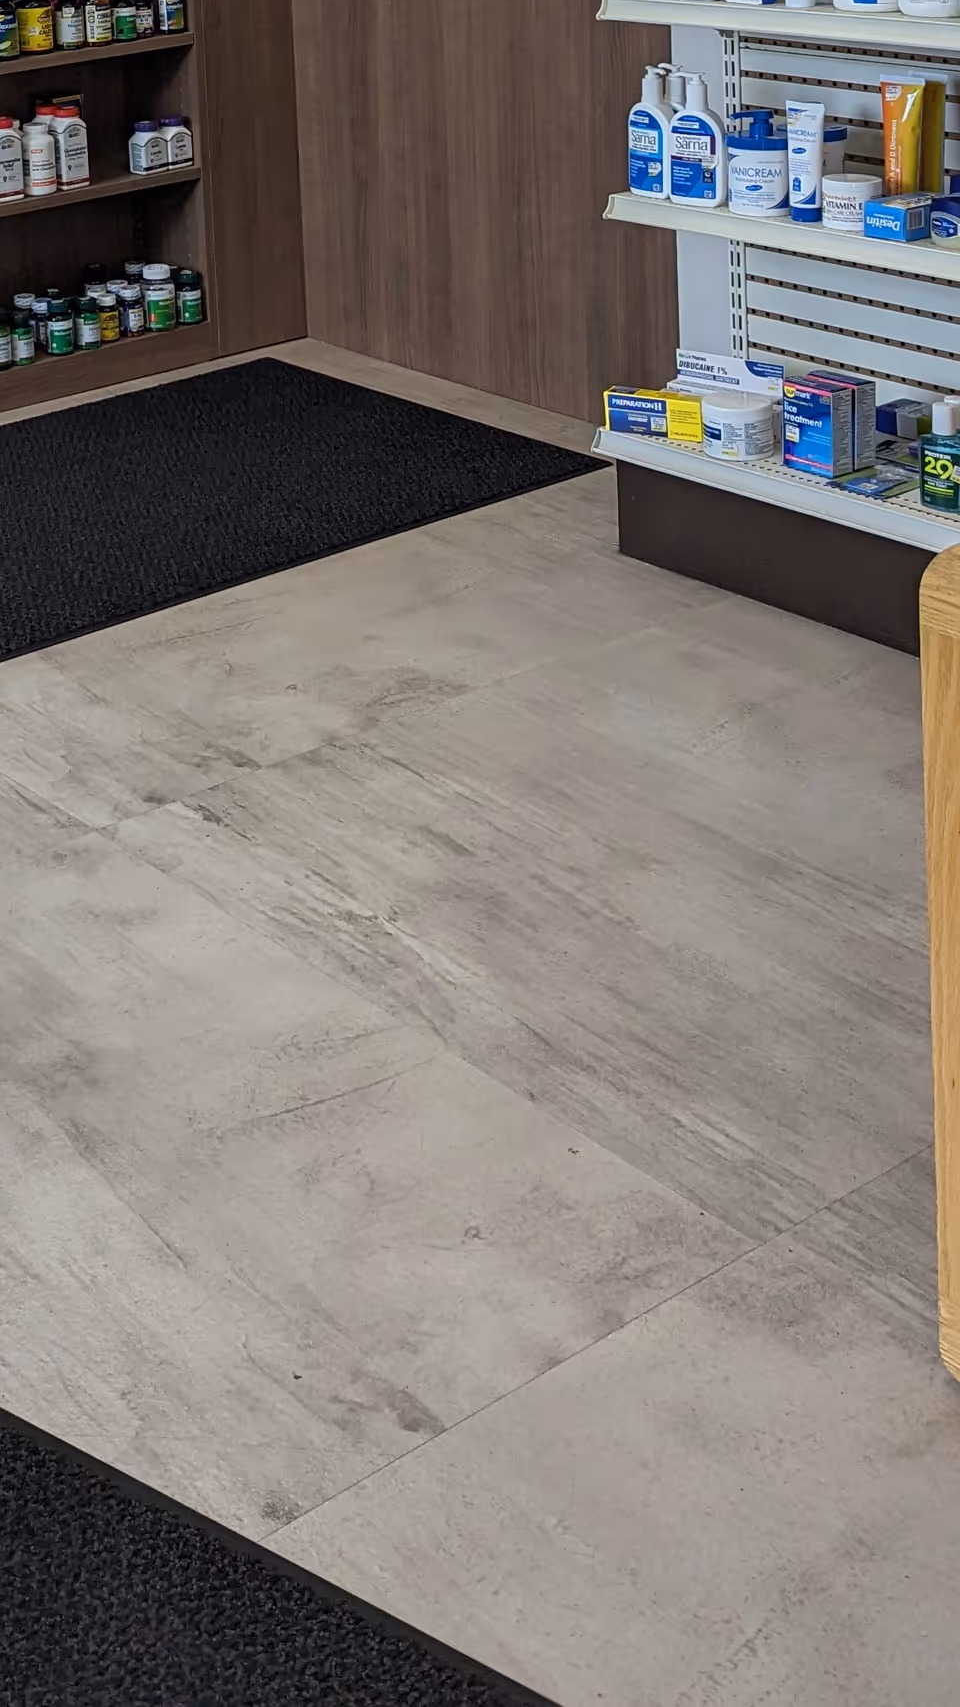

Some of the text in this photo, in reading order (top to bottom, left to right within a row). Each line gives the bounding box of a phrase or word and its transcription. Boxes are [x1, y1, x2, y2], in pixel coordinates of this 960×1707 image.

[631, 130, 656, 145] Sarna
[675, 136, 708, 151] Sarna
[731, 166, 782, 178] VANICREAM
[825, 201, 858, 211] VITAMIN
[866, 216, 901, 232] Desitin
[678, 360, 728, 375] DIBUCAINE 1%
[612, 397, 654, 409] PREPARATION
[784, 401, 798, 413] lice
[784, 412, 823, 427] treatment
[925, 456, 954, 480] 29
